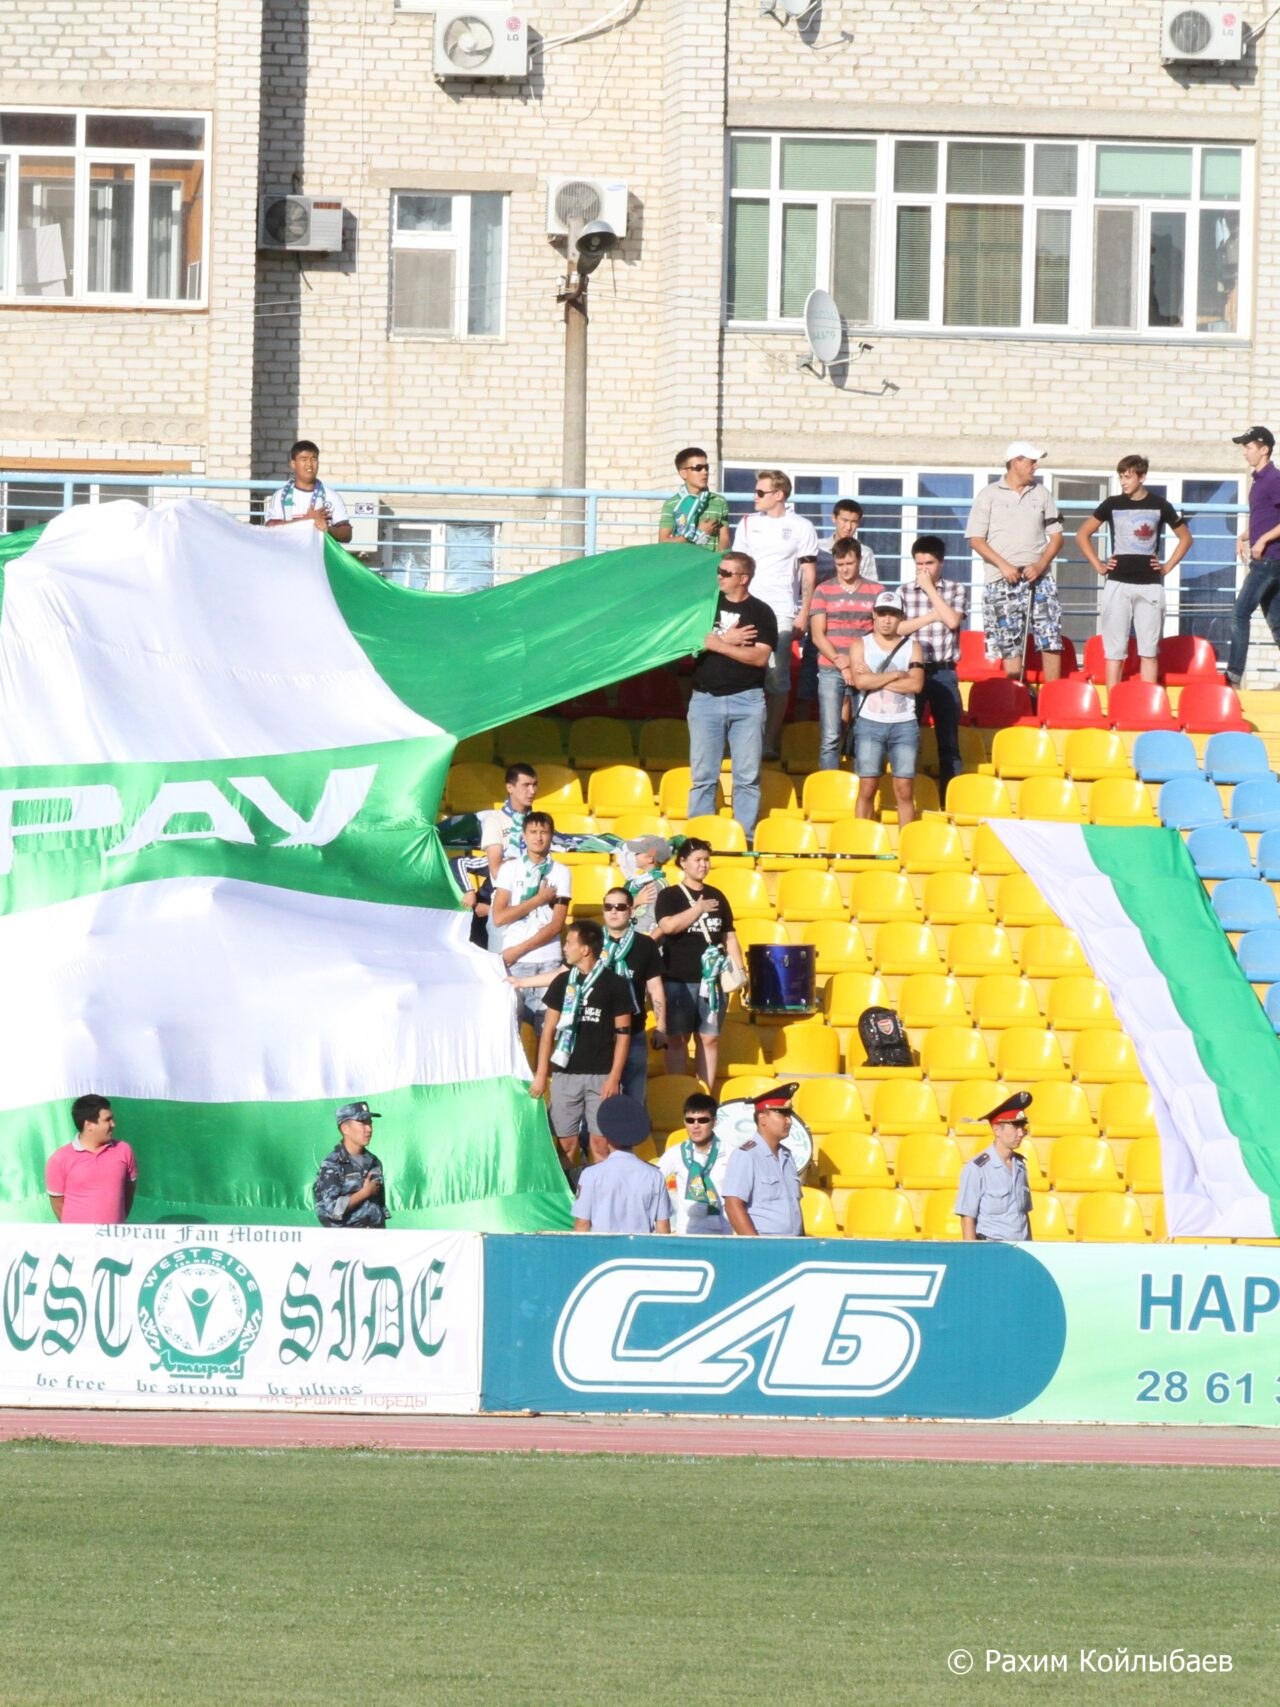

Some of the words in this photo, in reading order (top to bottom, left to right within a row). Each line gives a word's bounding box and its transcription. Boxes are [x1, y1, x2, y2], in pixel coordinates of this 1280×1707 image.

[507, 33, 519, 41] LG
[95, 1224, 166, 1241] Atyrau
[174, 1225, 219, 1244] Fan
[227, 1226, 303, 1244] Motion
[143, 1248, 200, 1289] WEST
[211, 1250, 258, 1293] SIDE
[278, 1258, 447, 1366] SIDE
[36, 1373, 58, 1388] be
[66, 1374, 107, 1391] free
[136, 1379, 158, 1393] be
[167, 1382, 238, 1397] strong
[268, 1383, 289, 1396] be
[300, 1383, 363, 1396] ultras
[1136, 1370, 1188, 1403] 28
[1206, 1372, 1252, 1404] 61
